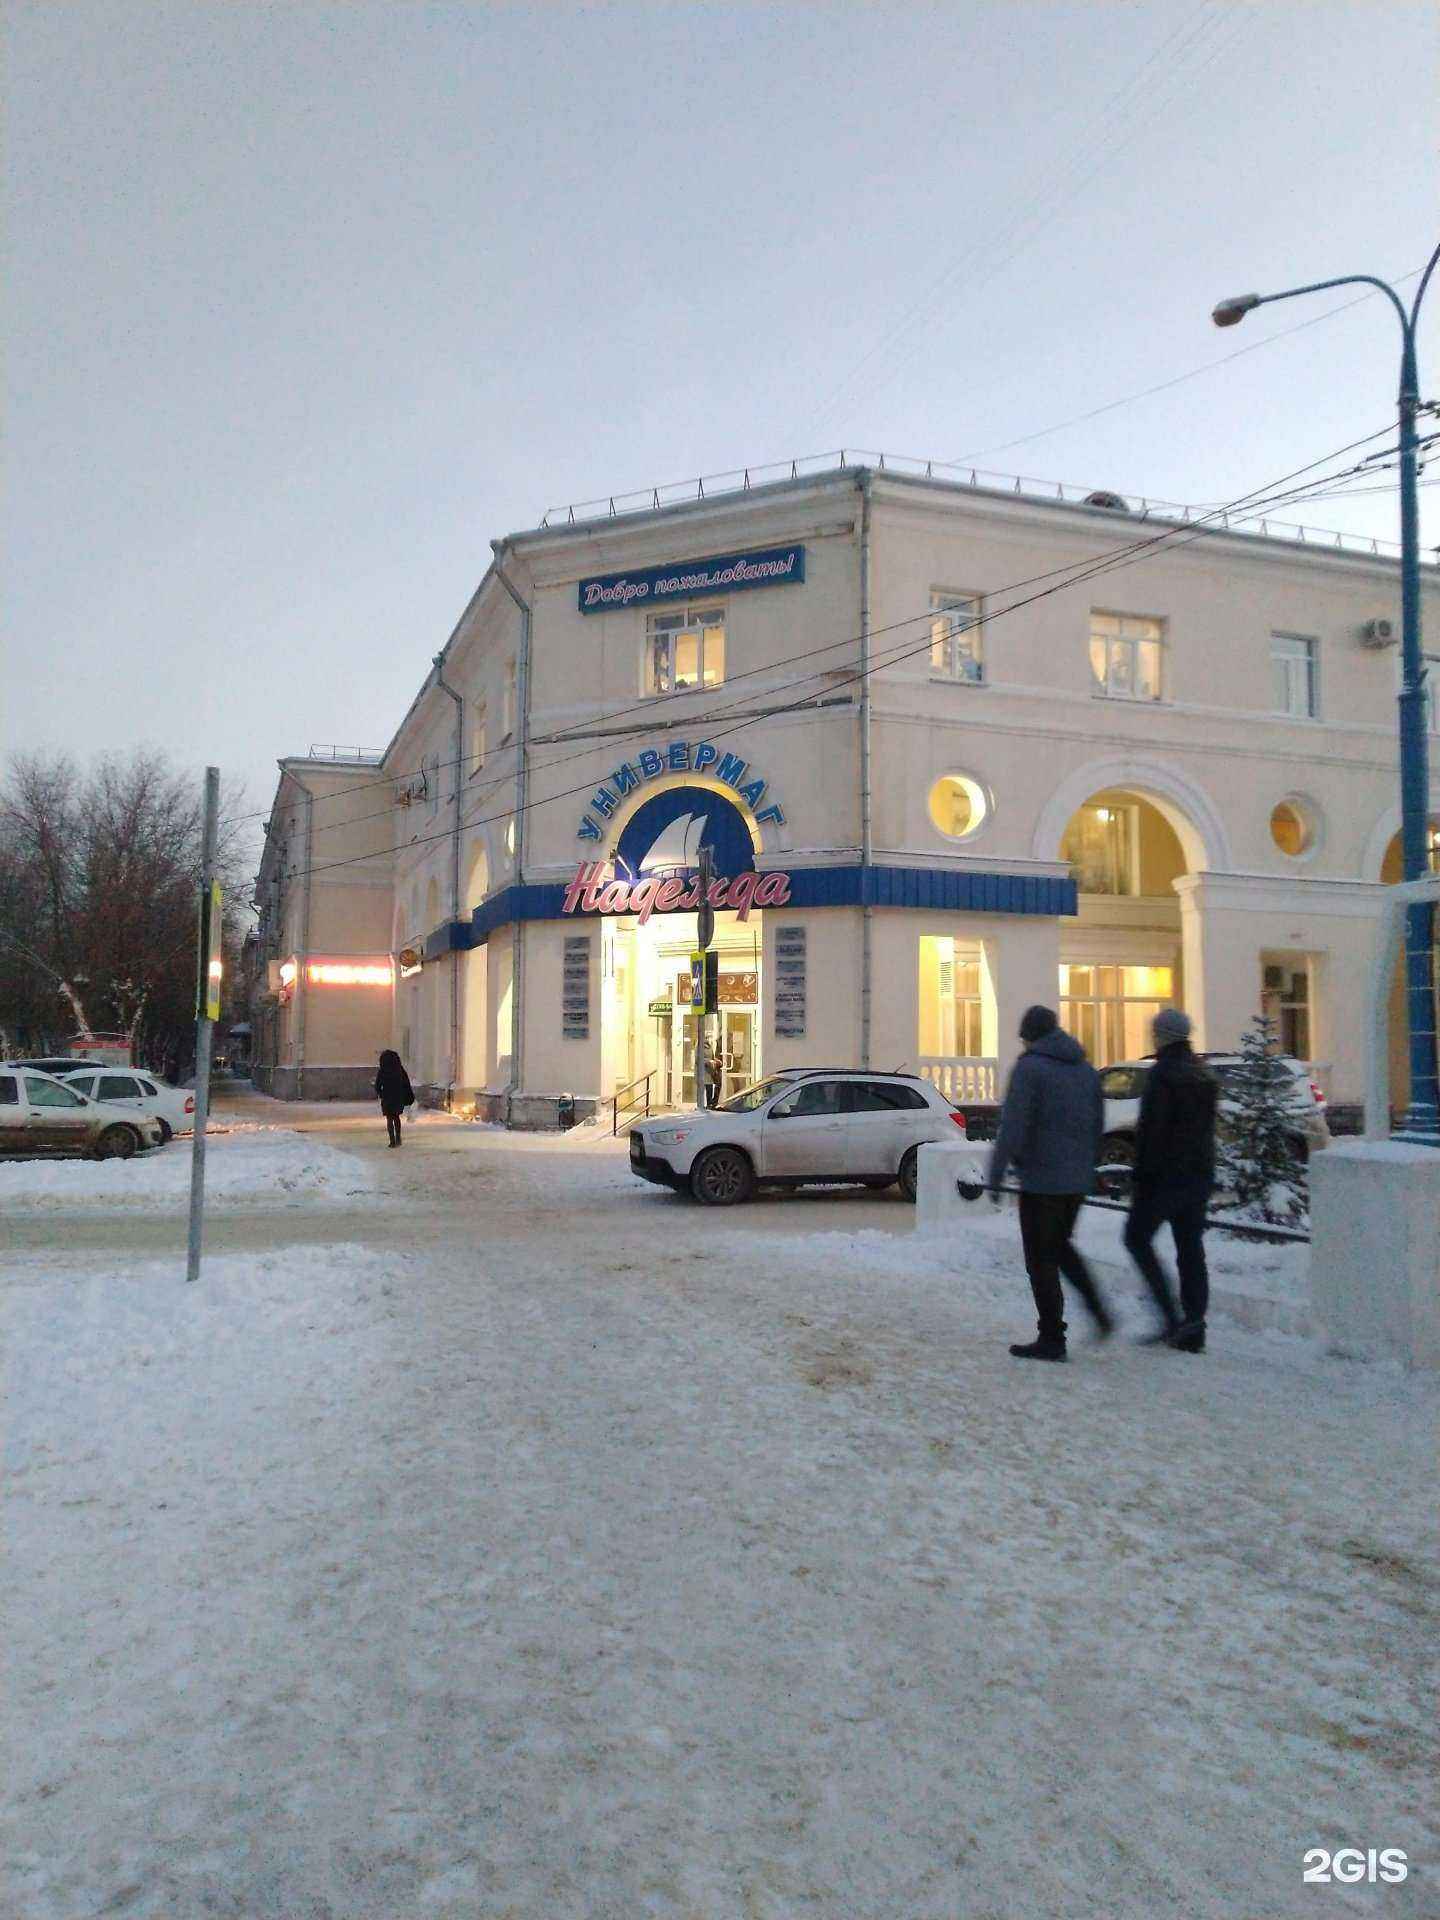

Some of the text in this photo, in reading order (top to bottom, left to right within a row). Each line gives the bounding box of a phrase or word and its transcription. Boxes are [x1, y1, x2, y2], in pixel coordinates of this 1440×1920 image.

[584, 553, 795, 605] Добро пожаловать!
[576, 741, 785, 841] УНИВЕРМАГ
